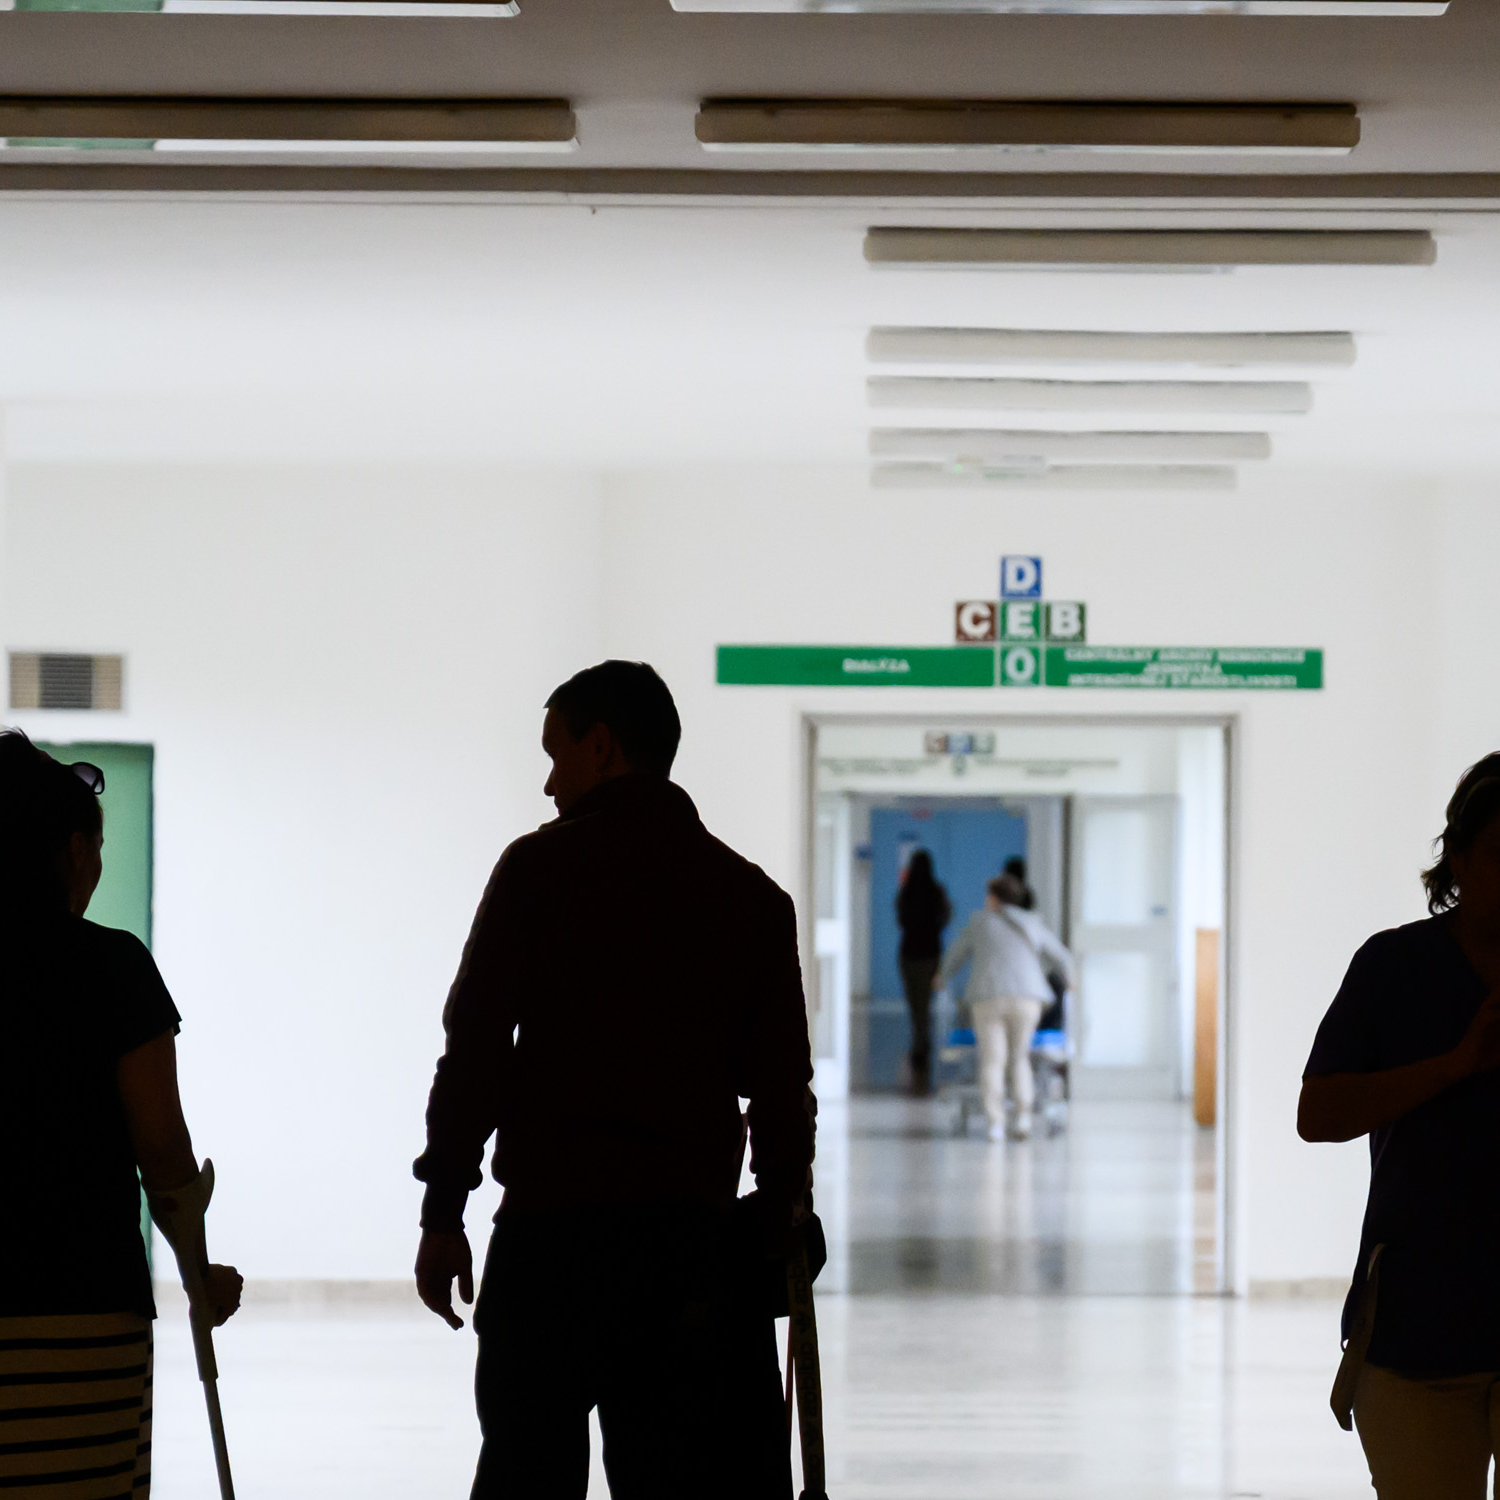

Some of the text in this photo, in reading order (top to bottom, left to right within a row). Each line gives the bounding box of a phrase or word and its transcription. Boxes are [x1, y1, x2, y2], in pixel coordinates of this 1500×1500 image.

[1005, 558, 1037, 591] D
[960, 600, 1080, 638] C E B
